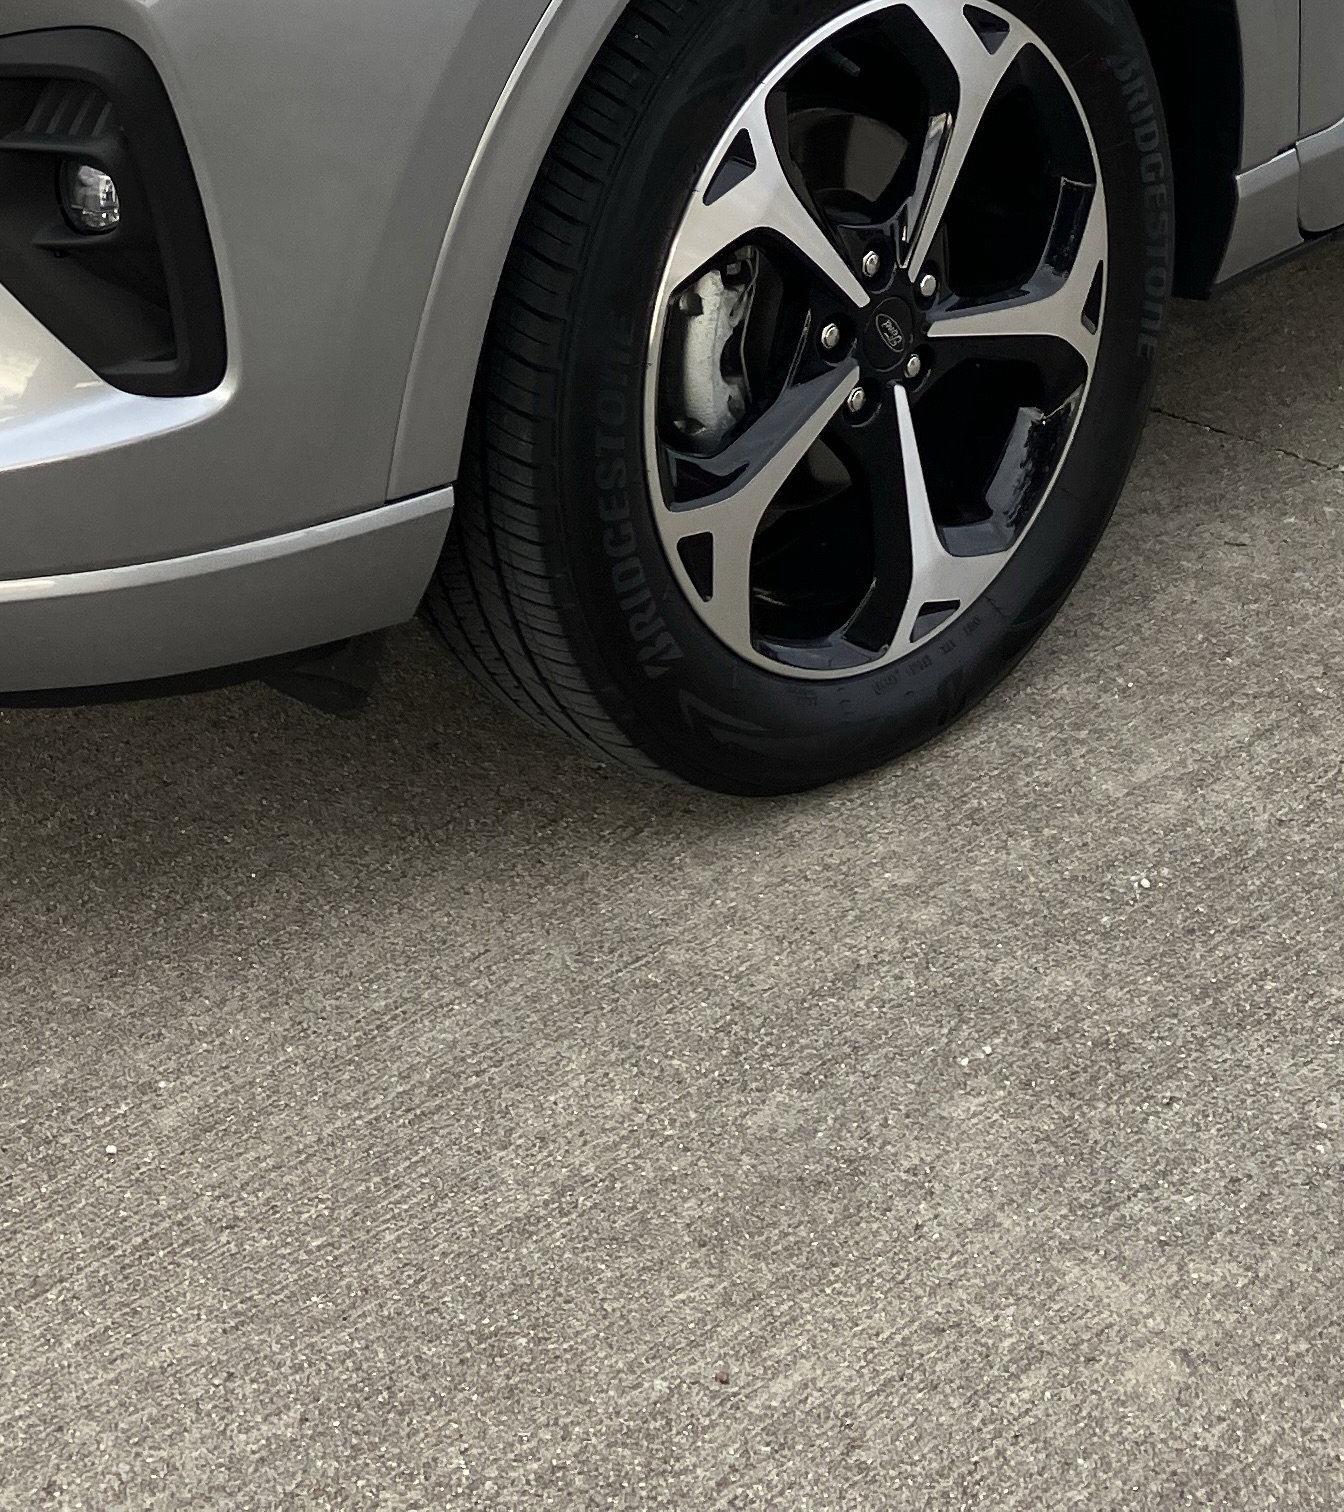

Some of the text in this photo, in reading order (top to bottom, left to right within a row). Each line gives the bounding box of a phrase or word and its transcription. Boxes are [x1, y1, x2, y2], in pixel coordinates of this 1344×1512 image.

[881, 319, 903, 347] Ford
[1109, 44, 1172, 359] BRIDGESTONE
[594, 311, 685, 679] BRIDGESTONE
